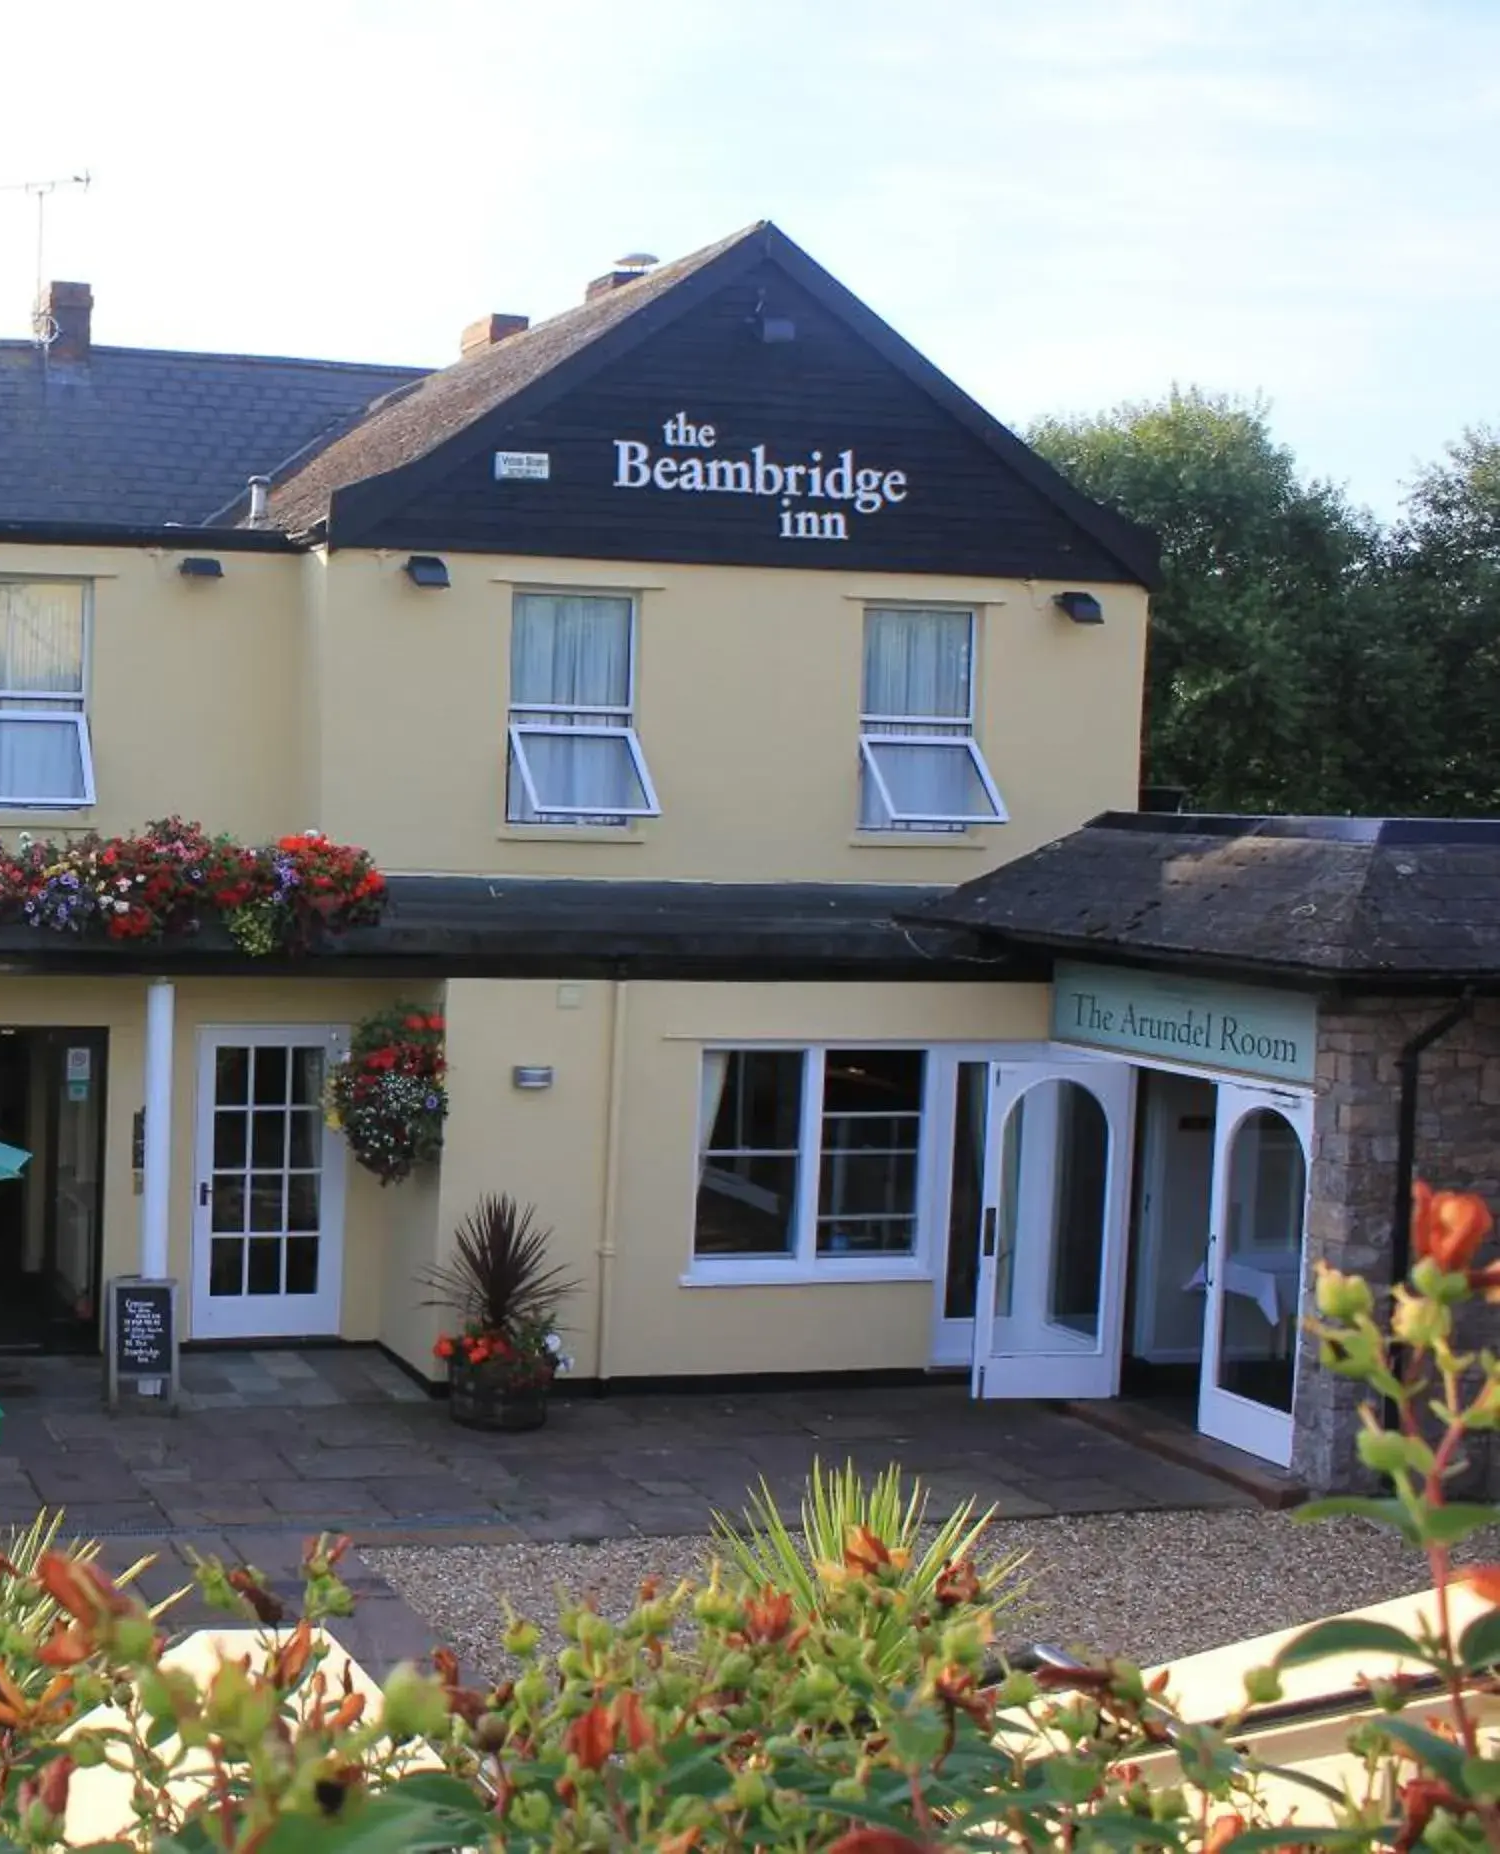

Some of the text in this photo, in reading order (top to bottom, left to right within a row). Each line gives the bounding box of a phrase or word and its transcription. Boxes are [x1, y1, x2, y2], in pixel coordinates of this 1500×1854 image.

[663, 411, 716, 448] the
[613, 439, 908, 513] Beambridge
[779, 498, 849, 540] inn
[1071, 993, 1297, 1064] The Arundel Room
